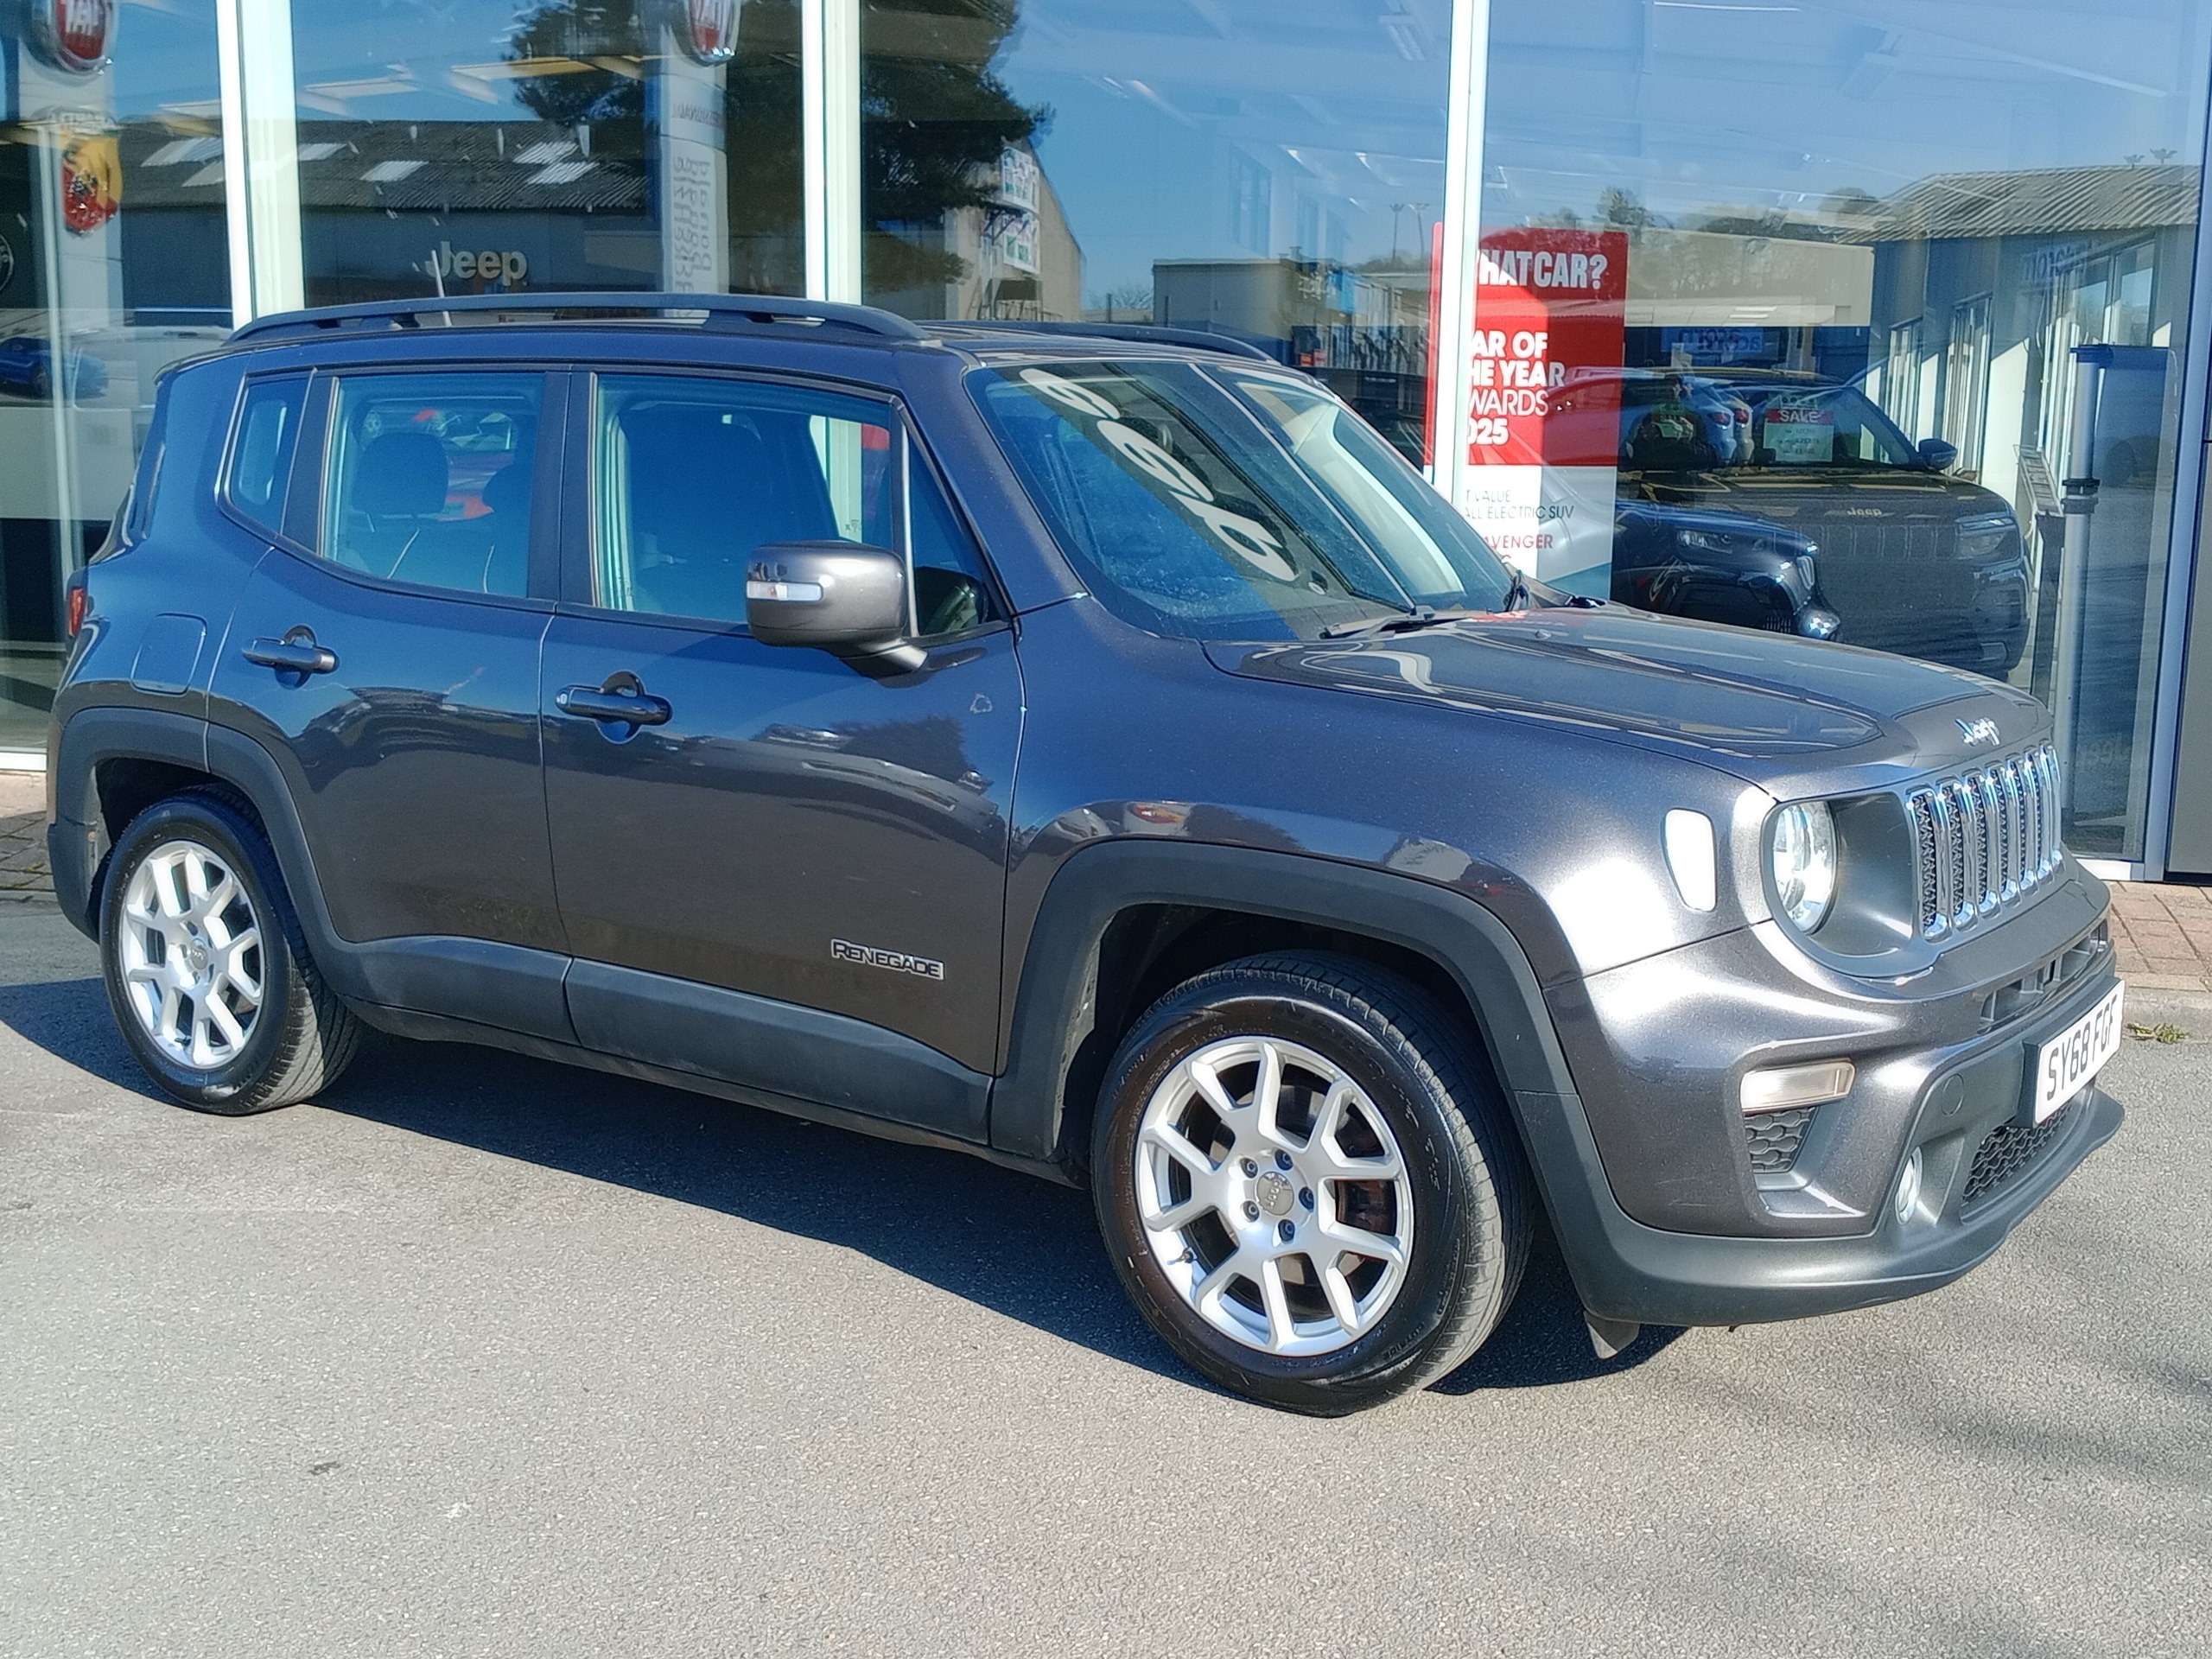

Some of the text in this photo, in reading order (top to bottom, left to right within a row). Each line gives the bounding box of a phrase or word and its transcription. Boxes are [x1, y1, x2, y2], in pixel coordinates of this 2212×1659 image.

[425, 241, 527, 287] Jeep
[1477, 249, 1608, 289] HATCAR?
[1471, 330, 1548, 359] AR OF
[1498, 359, 1566, 387] YEAR
[1470, 389, 1548, 416] WARDS
[1780, 410, 1819, 423] SALE
[1468, 416, 1510, 445] 025
[1548, 505, 1575, 518] SUV
[831, 938, 944, 980] RENEGADE
[2046, 1020, 2091, 1102] SY68
